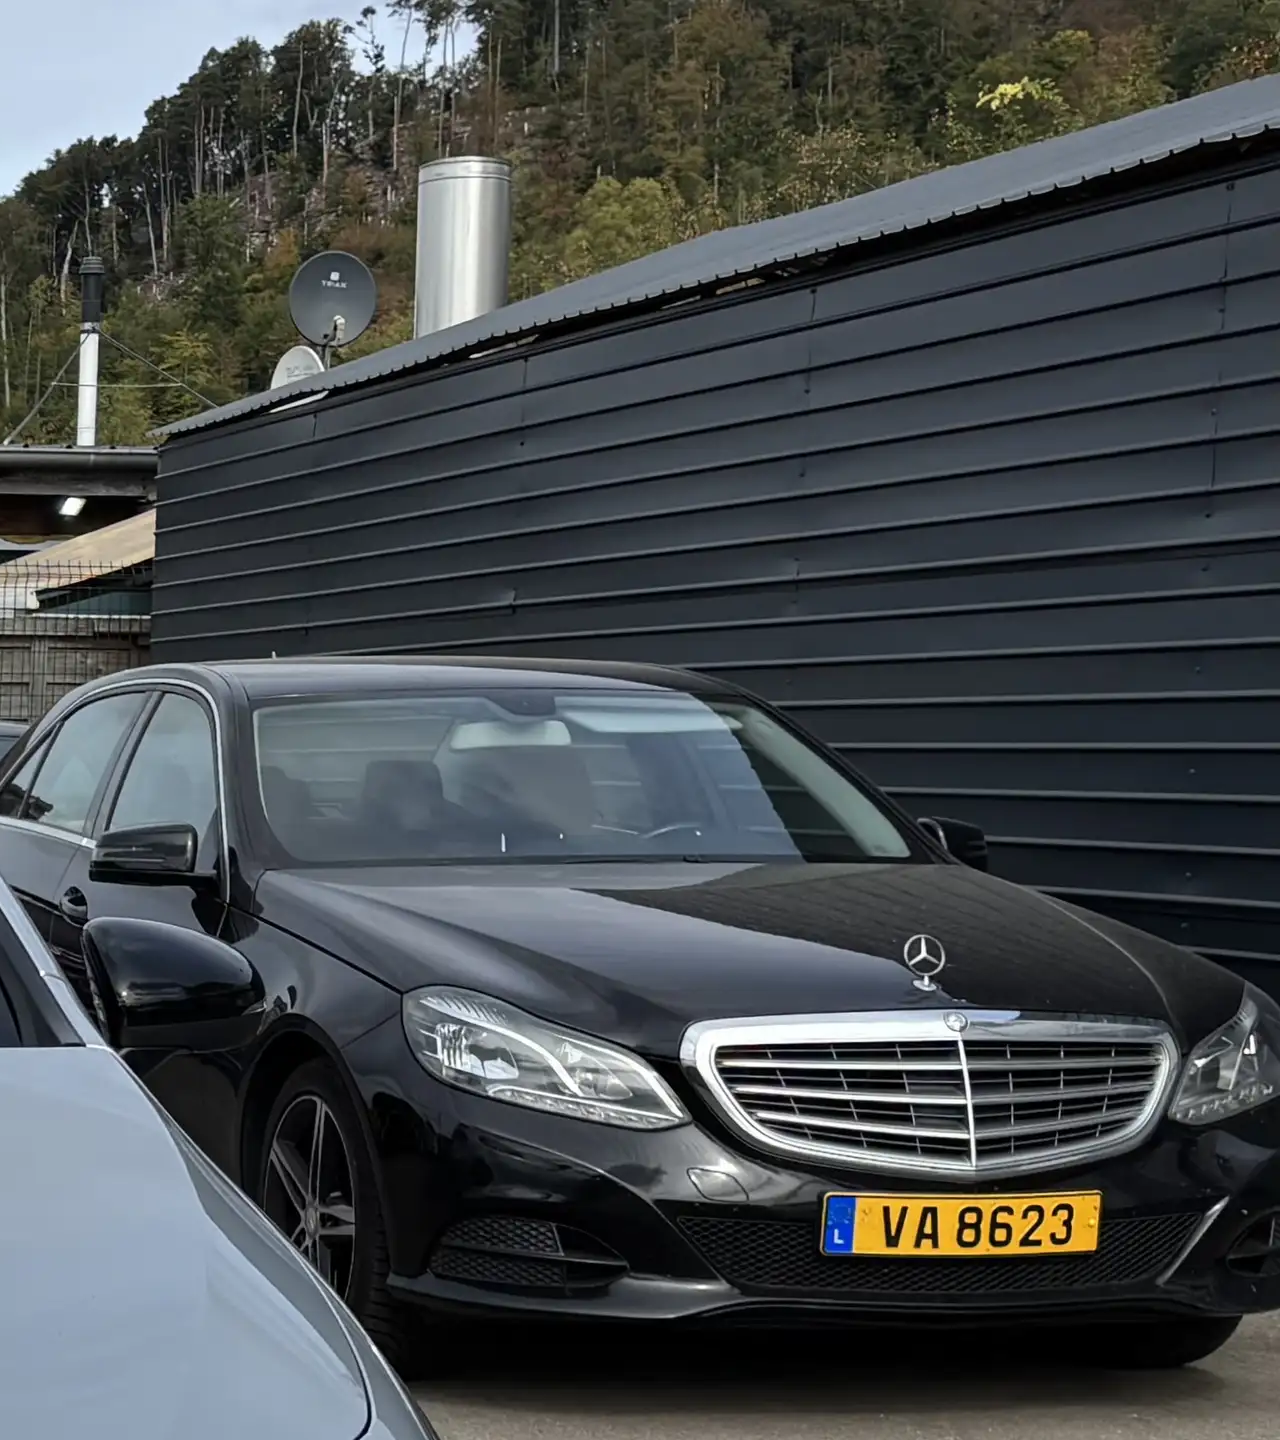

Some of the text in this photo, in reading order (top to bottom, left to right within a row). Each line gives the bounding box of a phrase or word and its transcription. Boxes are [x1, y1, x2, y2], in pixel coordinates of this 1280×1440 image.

[833, 1228, 845, 1245] L
[882, 1202, 1075, 1249] VA 8623
